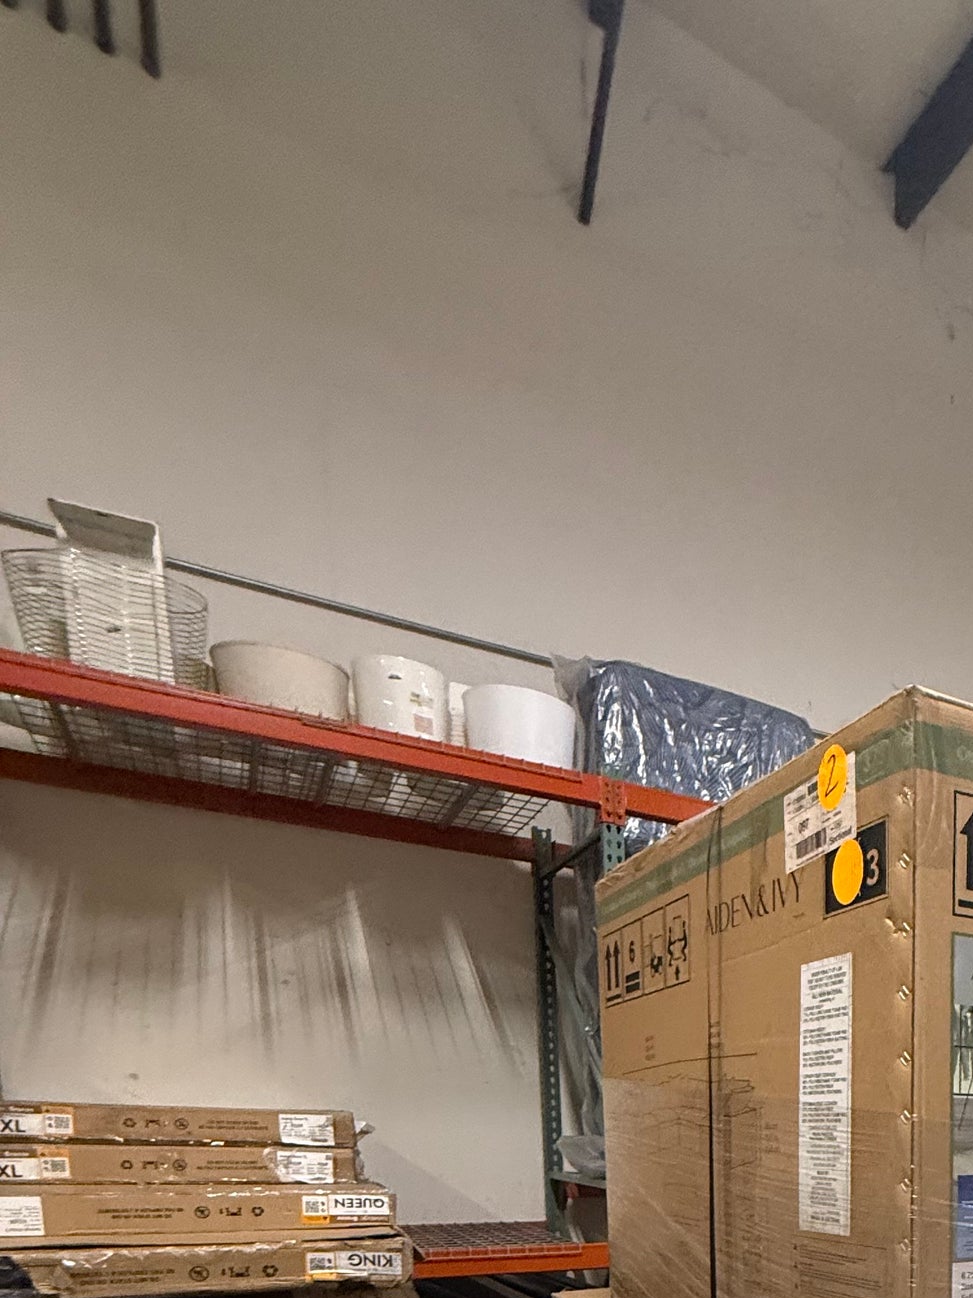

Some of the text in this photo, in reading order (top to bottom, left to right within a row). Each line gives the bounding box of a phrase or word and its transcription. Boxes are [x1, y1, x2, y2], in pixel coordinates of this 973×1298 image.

[866, 849, 880, 886] 3
[628, 940, 636, 963] 6
[0, 1118, 26, 1133] XL
[0, 1164, 23, 1178] XL
[334, 1198, 385, 1209] QUEEN
[347, 1254, 393, 1268] KING
